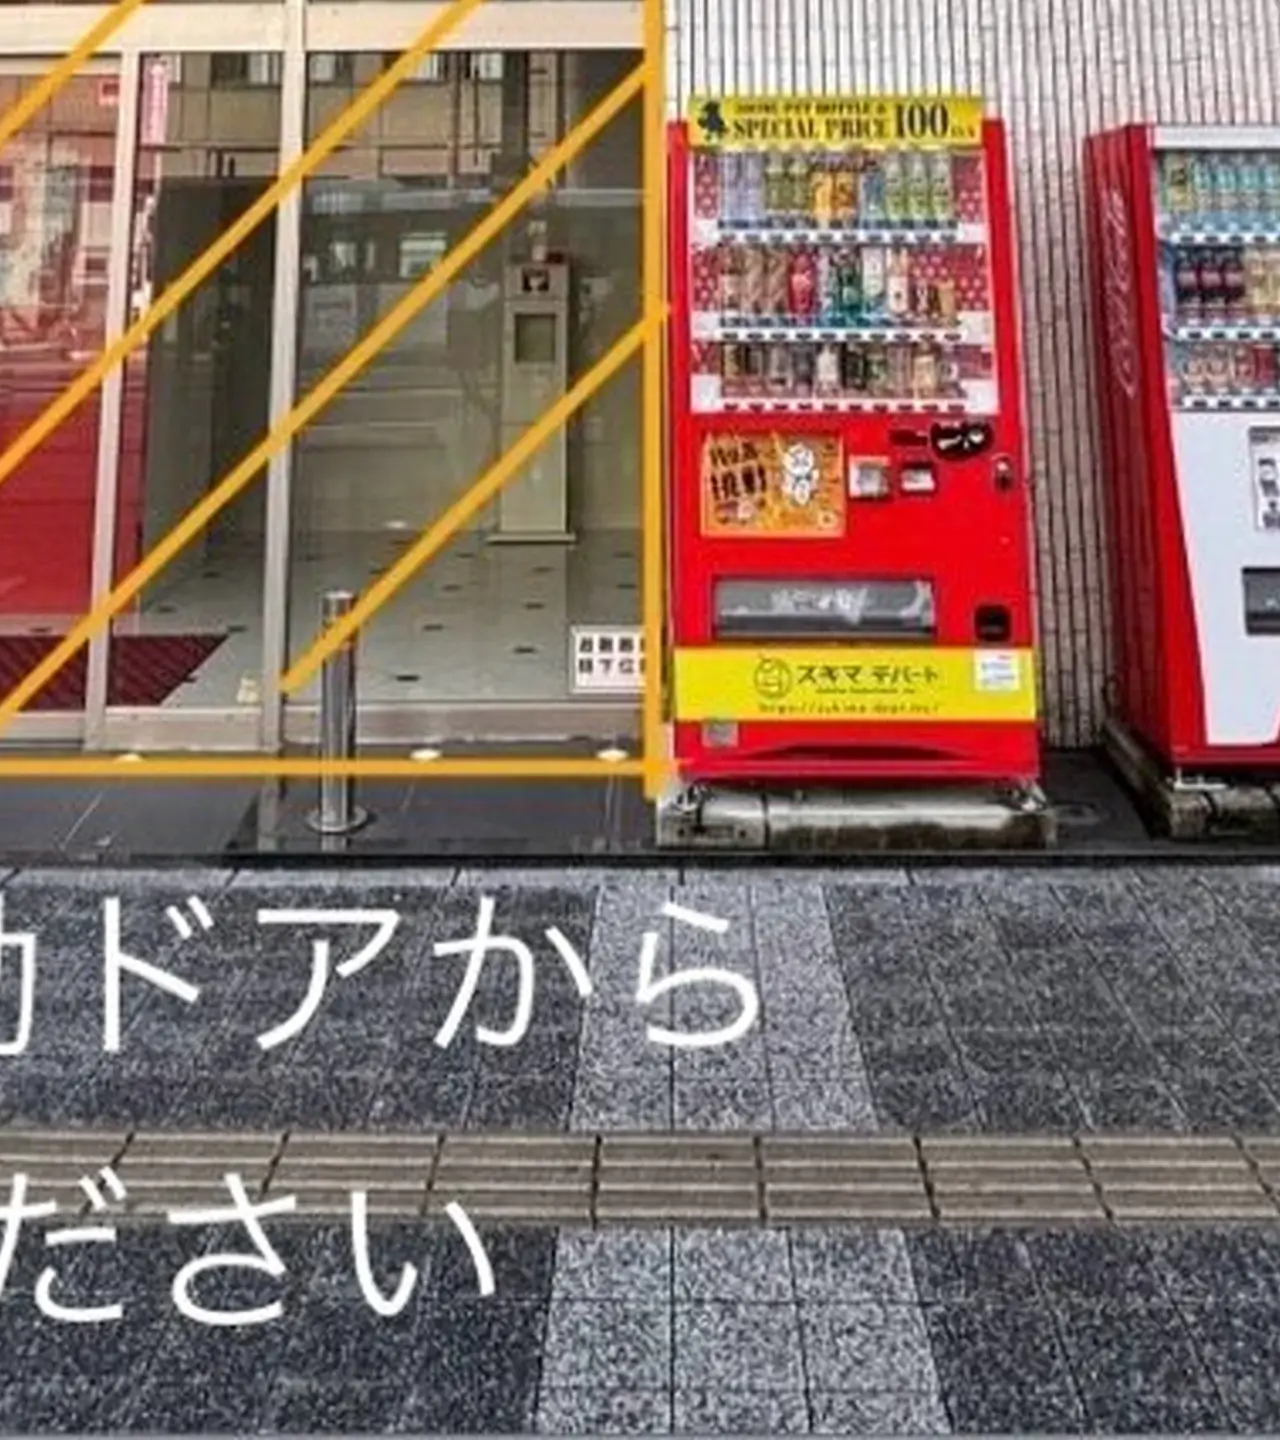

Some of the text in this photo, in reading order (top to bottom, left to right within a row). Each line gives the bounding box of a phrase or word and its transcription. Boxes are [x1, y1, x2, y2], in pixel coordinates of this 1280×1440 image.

[733, 117, 820, 139] SPECIAL
[824, 117, 889, 139] PRICE
[894, 101, 950, 139] 100
[796, 664, 863, 685] スキマ
